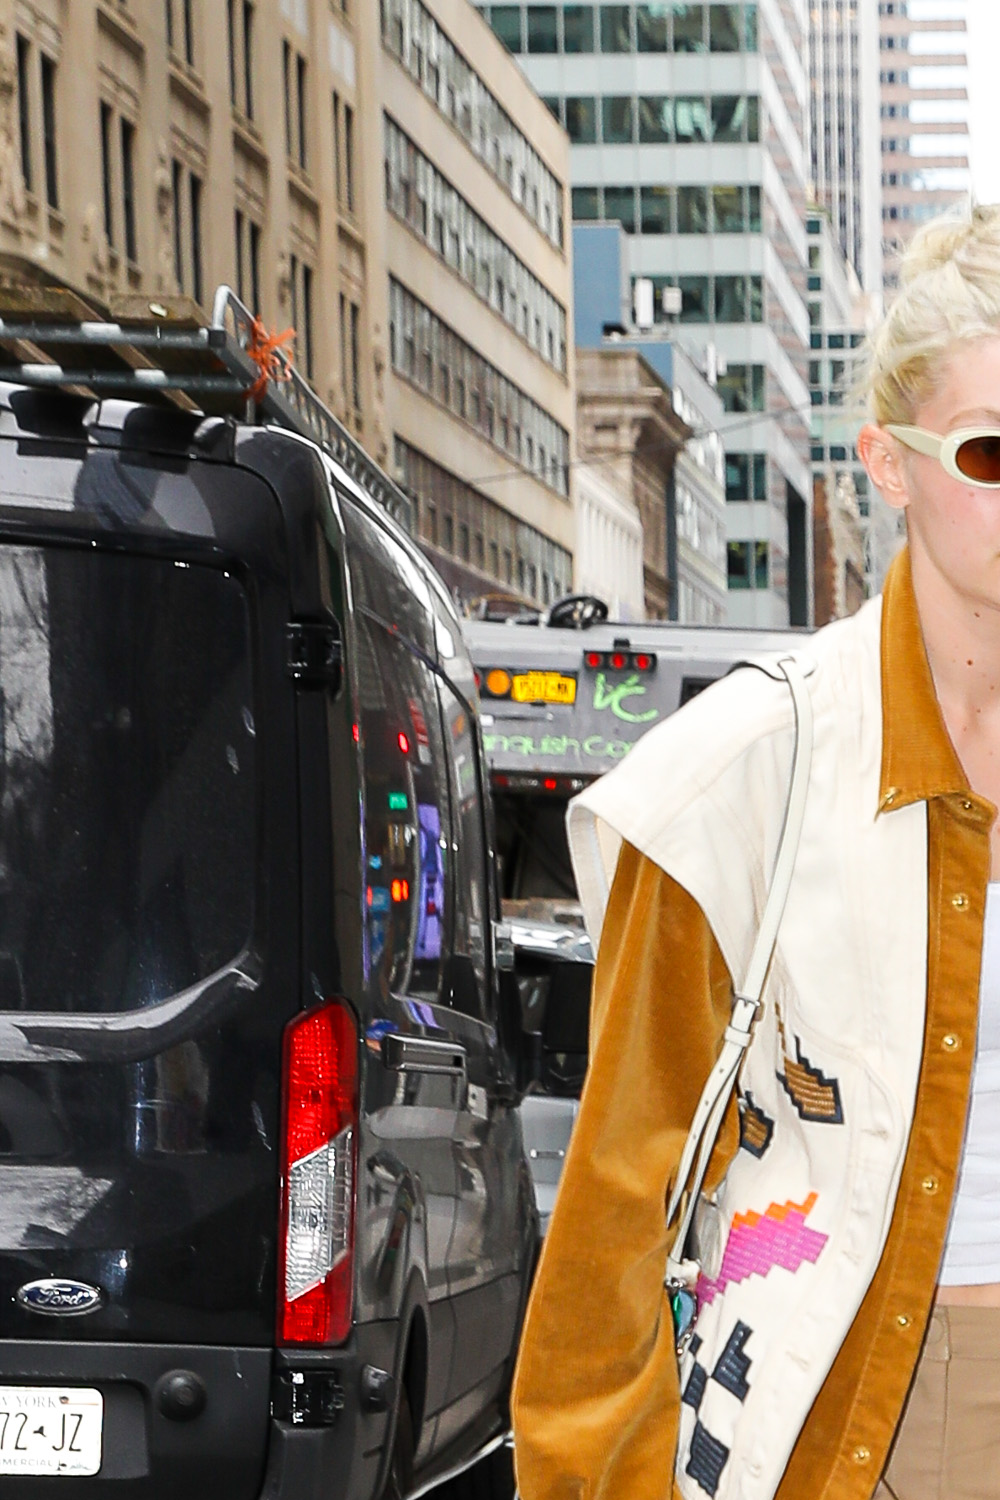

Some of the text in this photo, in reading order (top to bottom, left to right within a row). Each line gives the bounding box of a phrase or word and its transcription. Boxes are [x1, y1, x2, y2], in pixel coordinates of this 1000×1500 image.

[36, 1286, 87, 1305] Ford
[16, 1395, 57, 1408] YORK
[52, 1413, 83, 1452] JZ
[0, 1458, 53, 1468] MERCIAL
